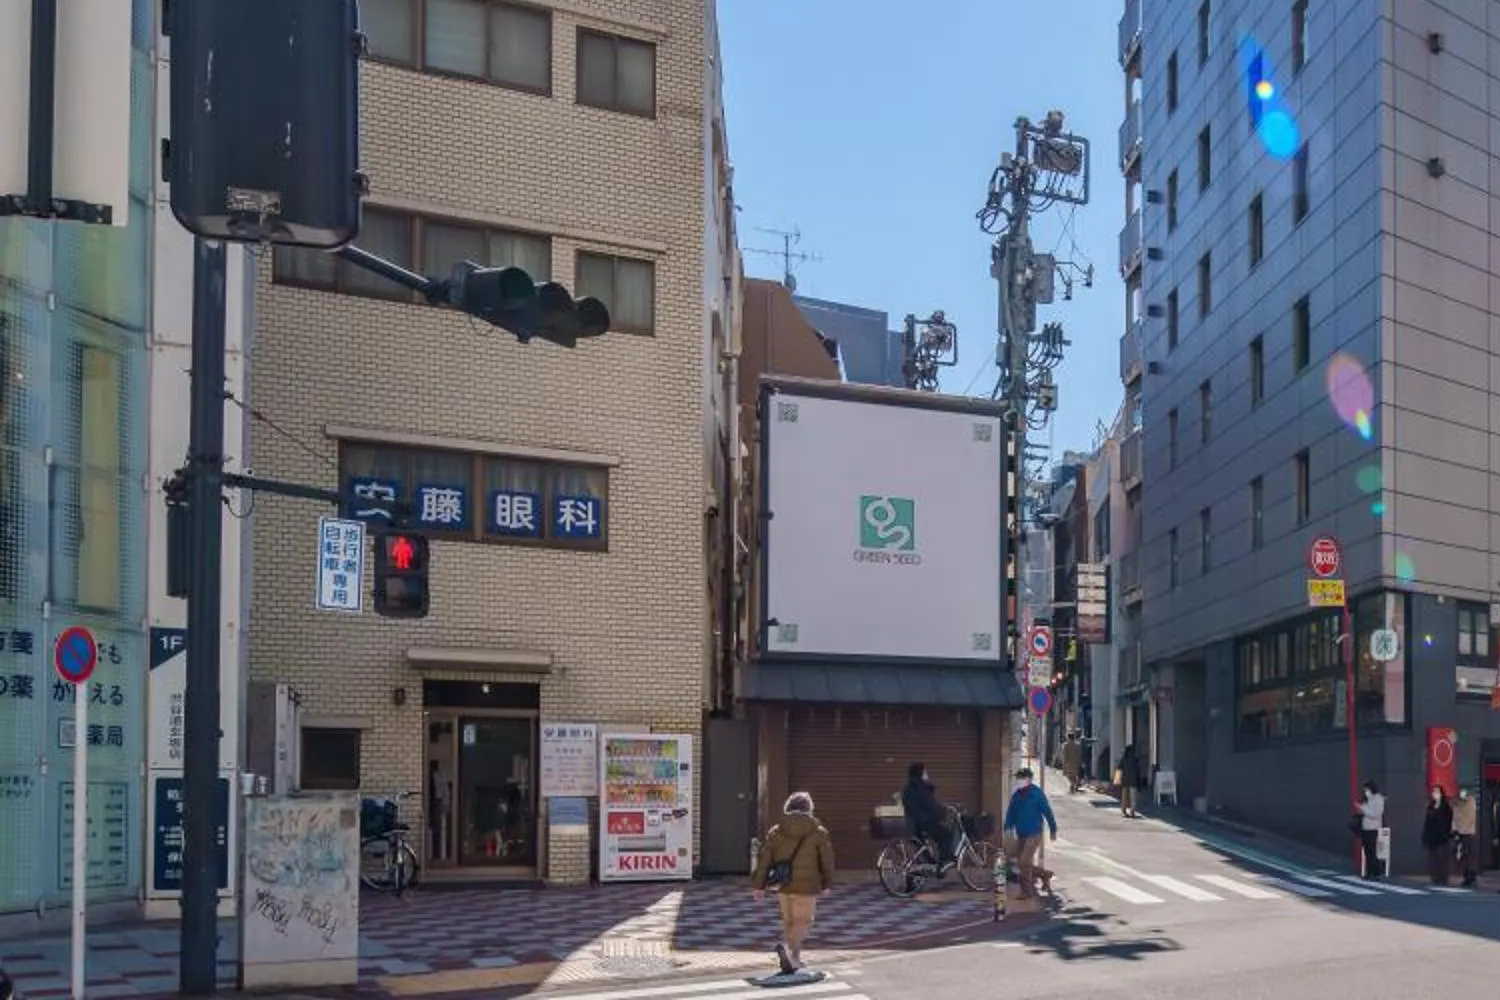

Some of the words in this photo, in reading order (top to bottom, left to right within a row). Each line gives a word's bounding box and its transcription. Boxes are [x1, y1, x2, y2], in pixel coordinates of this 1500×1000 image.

[53, 680, 124, 706] がえる
[618, 855, 678, 870] KIRIN
